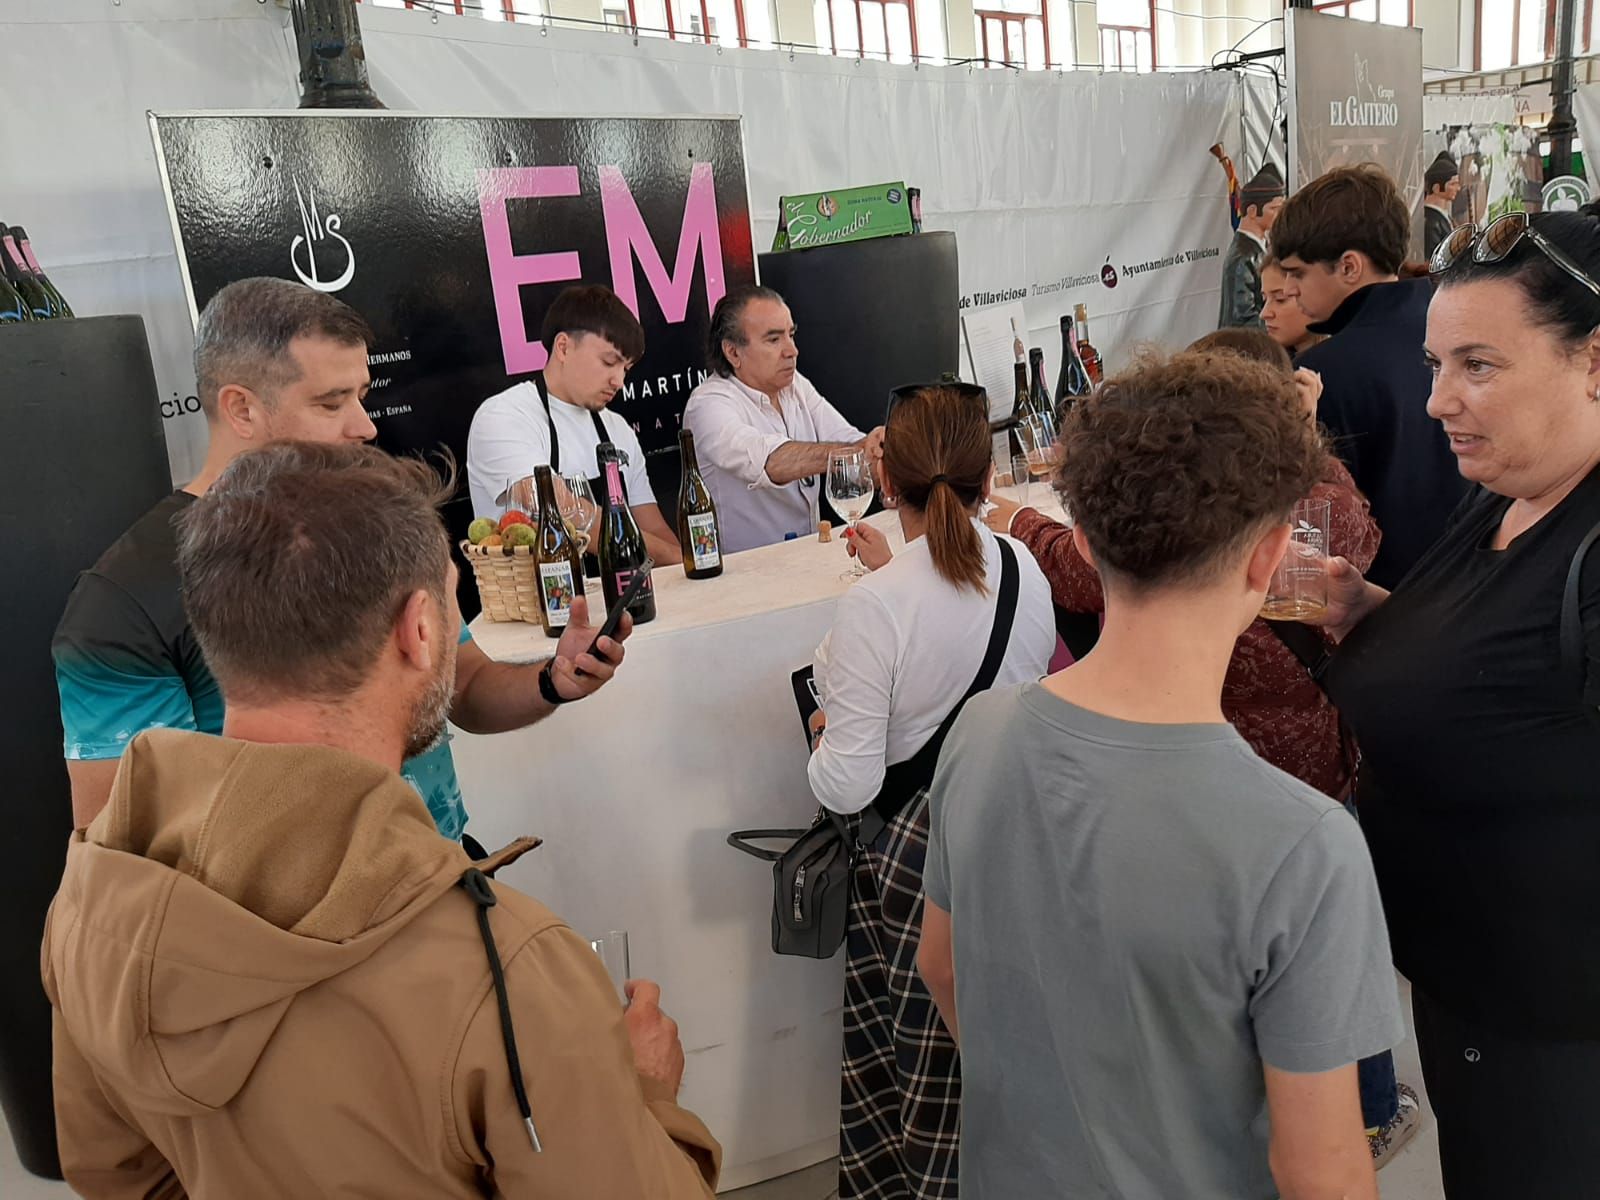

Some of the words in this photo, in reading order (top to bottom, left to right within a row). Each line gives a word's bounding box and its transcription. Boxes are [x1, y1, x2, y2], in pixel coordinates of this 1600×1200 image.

[787, 208, 873, 248] Gobernador
[476, 163, 726, 375] EM
[1175, 253, 1185, 265] de
[959, 295, 971, 309] de
[974, 287, 1027, 306] Villaviciosa
[1031, 281, 1060, 297] Turismo
[622, 366, 708, 402] MARTÍN
